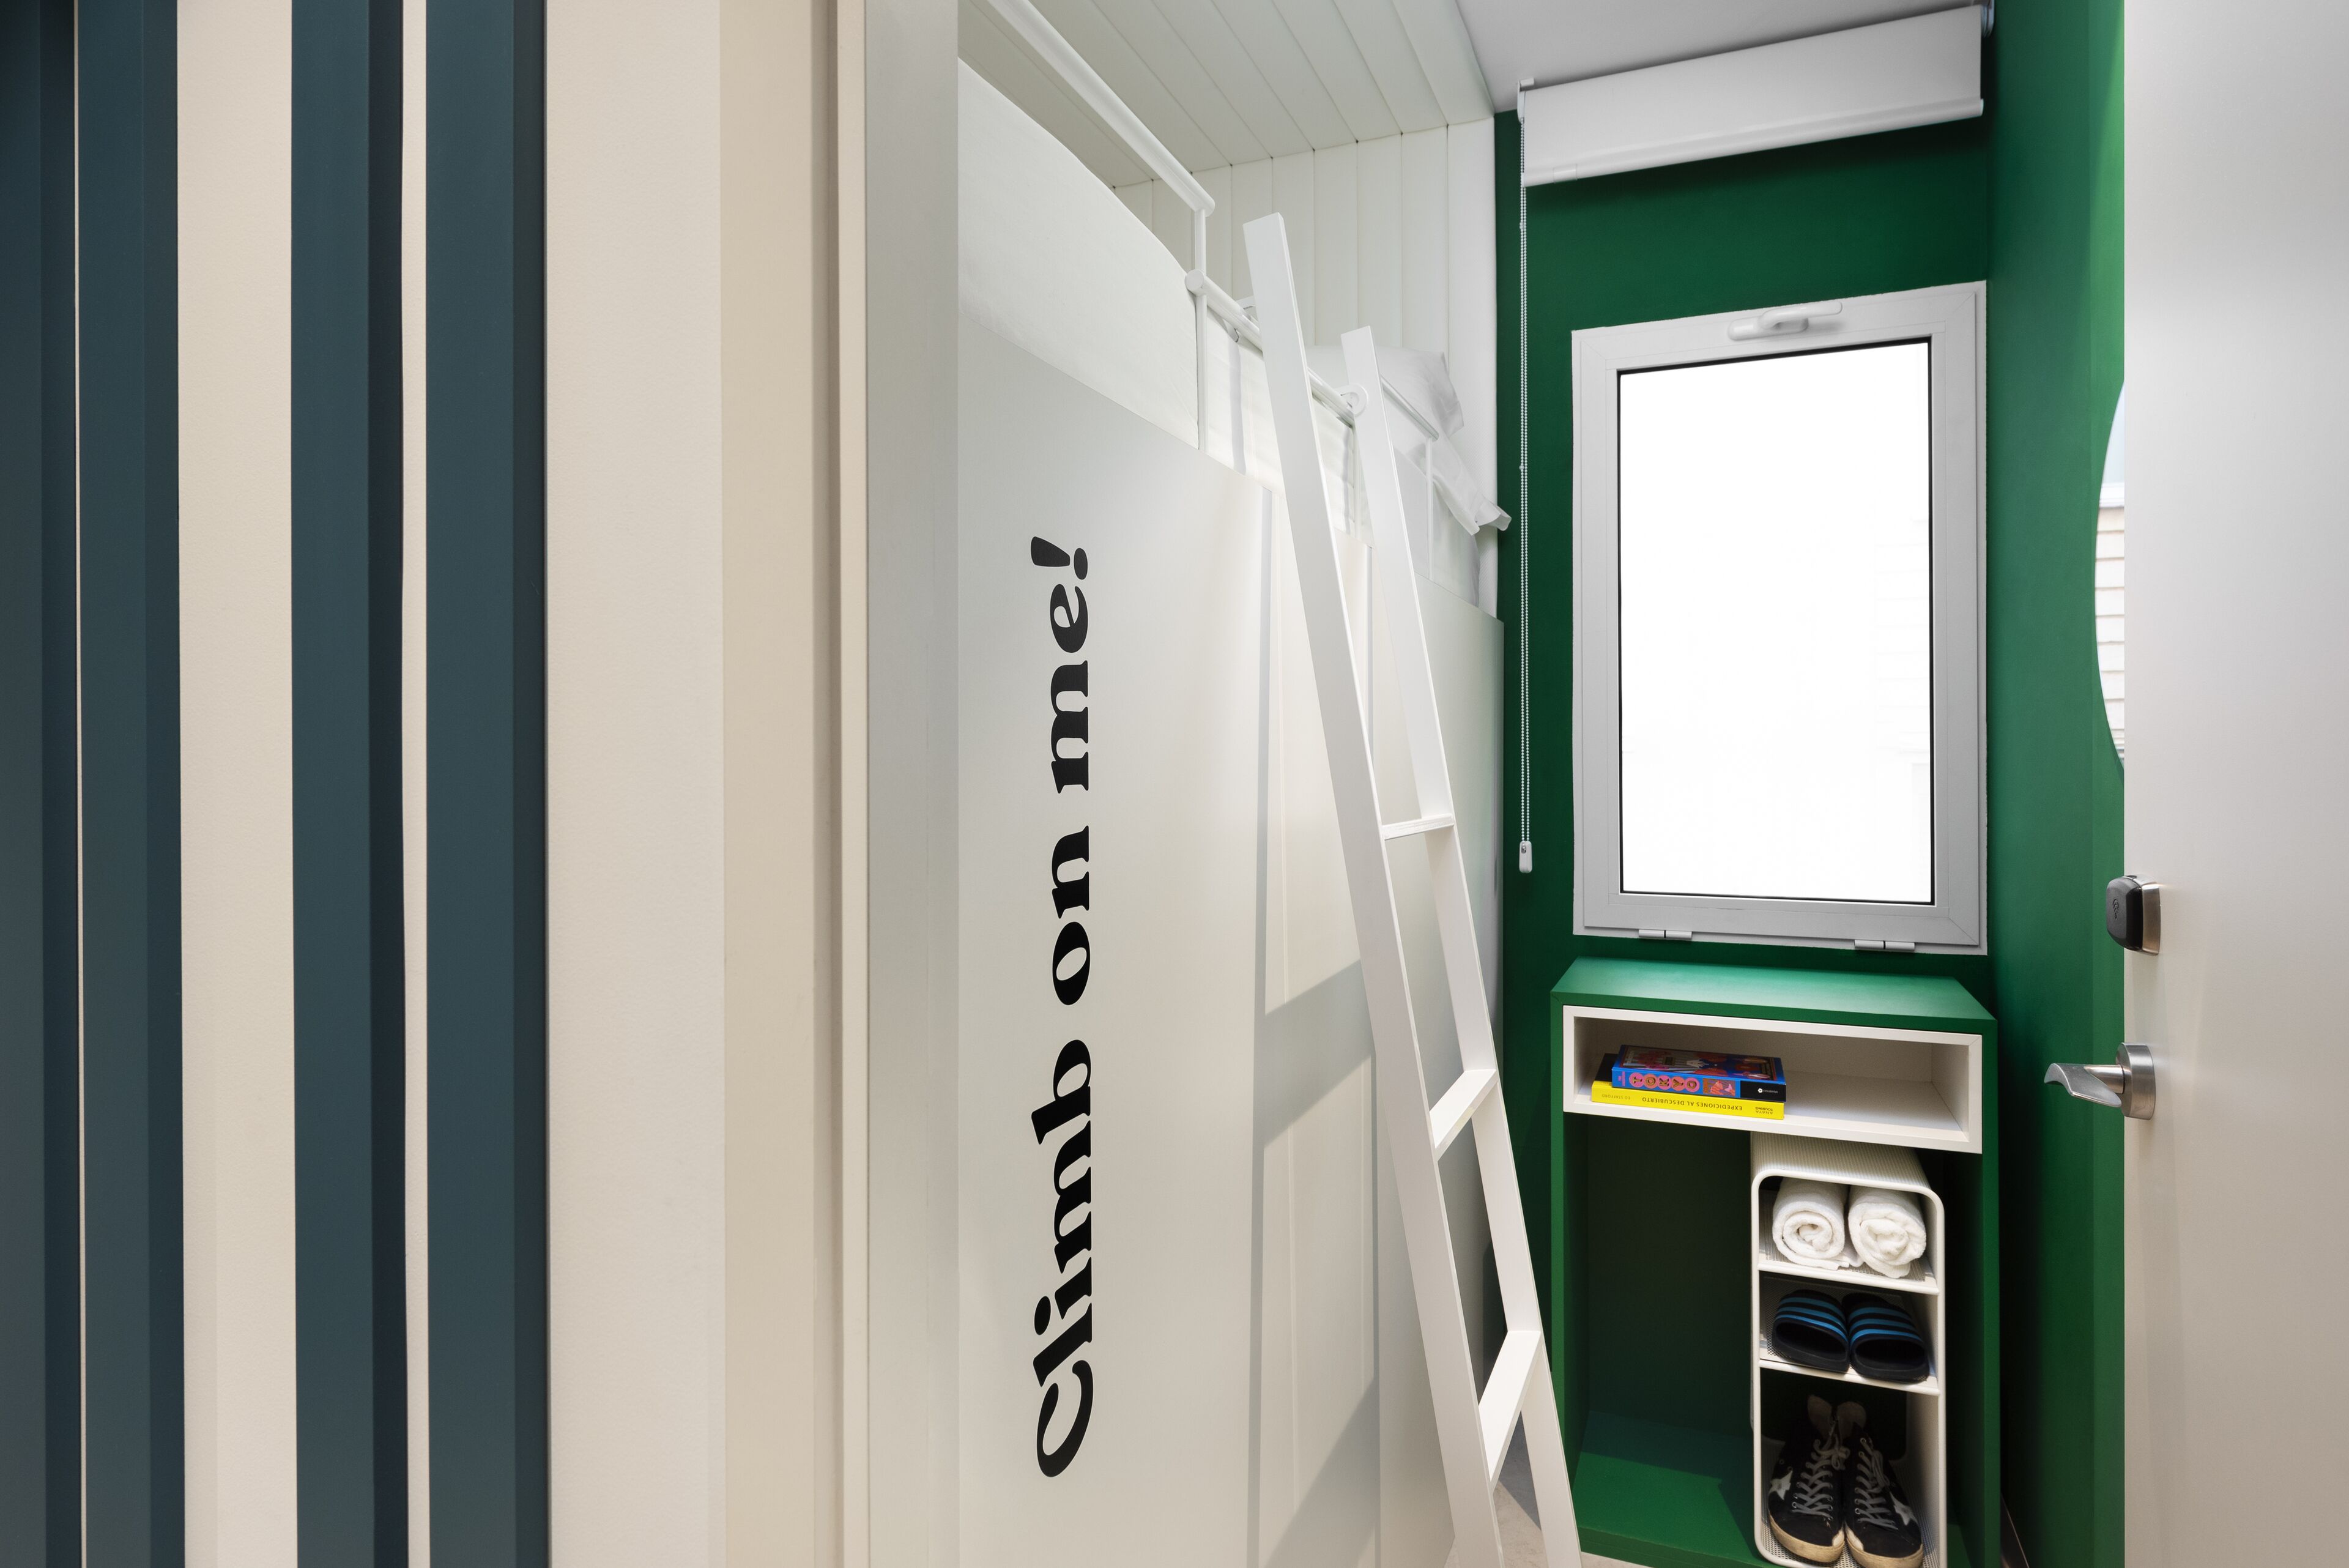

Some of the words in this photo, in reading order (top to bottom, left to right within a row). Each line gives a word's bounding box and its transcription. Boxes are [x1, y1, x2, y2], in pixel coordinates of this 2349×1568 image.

[1030, 536, 1089, 794] me!
[1052, 825, 1091, 1006] on
[1632, 1076, 1698, 1090] TOKYO
[1642, 1097, 1685, 1105] DESCUBIERTO
[1696, 1102, 1743, 1111] EXPEDICIONES
[1031, 1040, 1094, 1477] Climb
